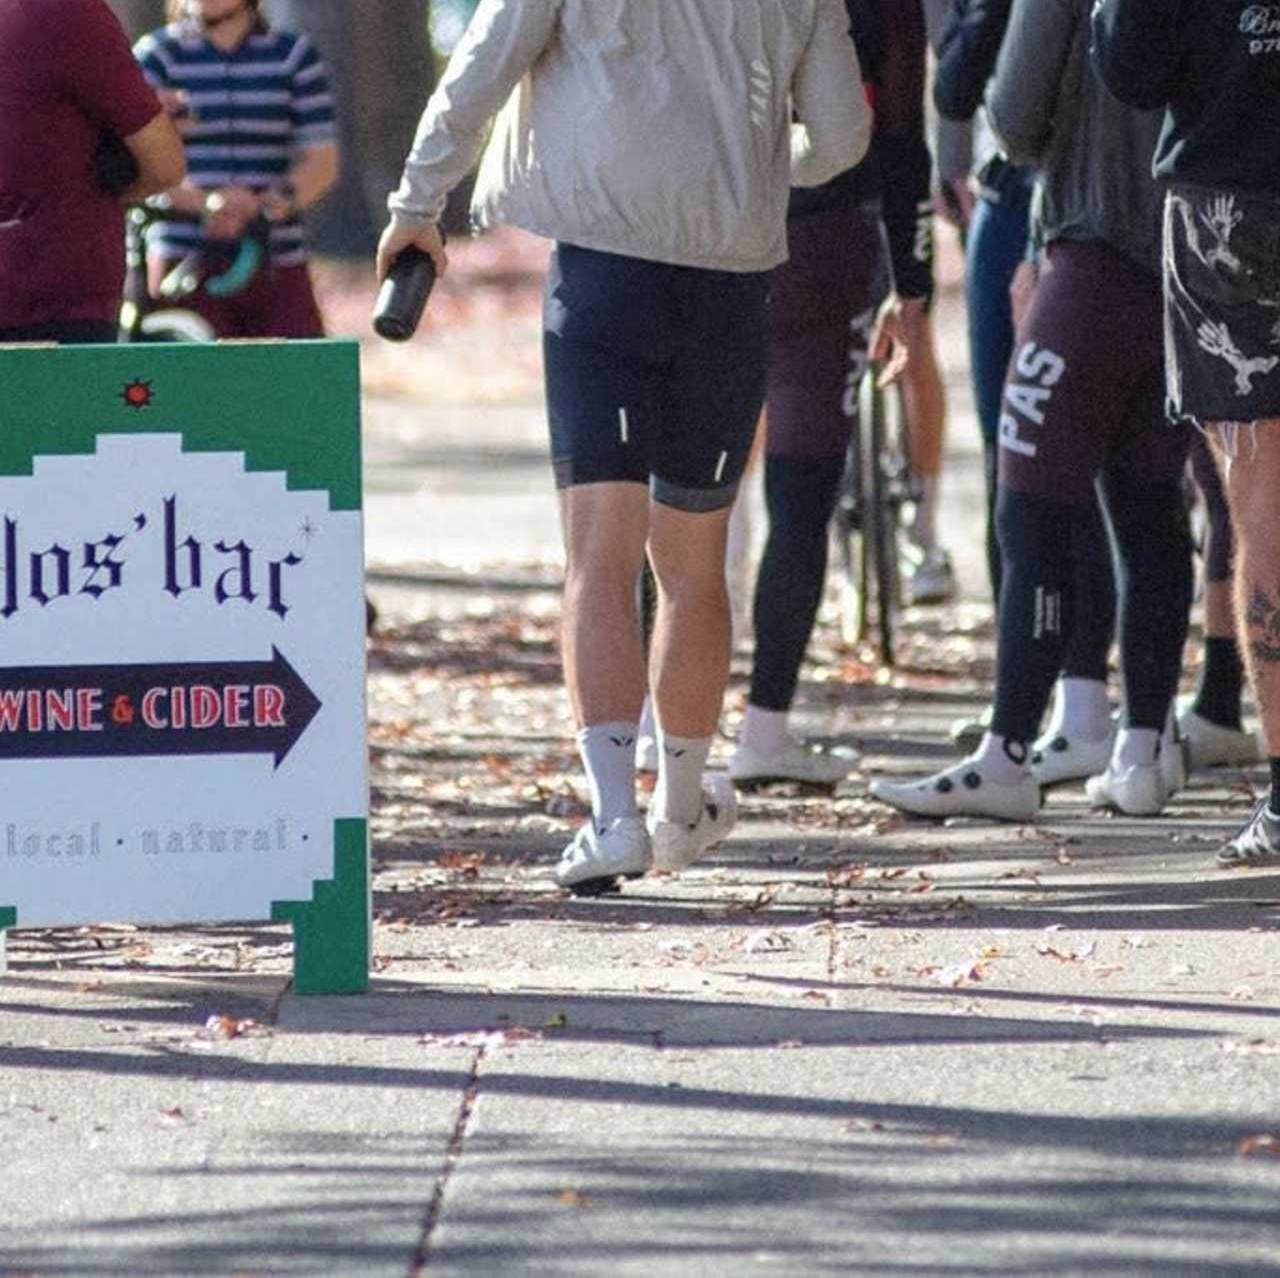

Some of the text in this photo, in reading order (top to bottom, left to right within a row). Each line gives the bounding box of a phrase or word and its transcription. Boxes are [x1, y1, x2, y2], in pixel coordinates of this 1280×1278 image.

[997, 340, 1066, 458] PAS
[111, 692, 135, 724] &
[141, 684, 287, 730] CIDER
[4, 817, 287, 858] local natural
